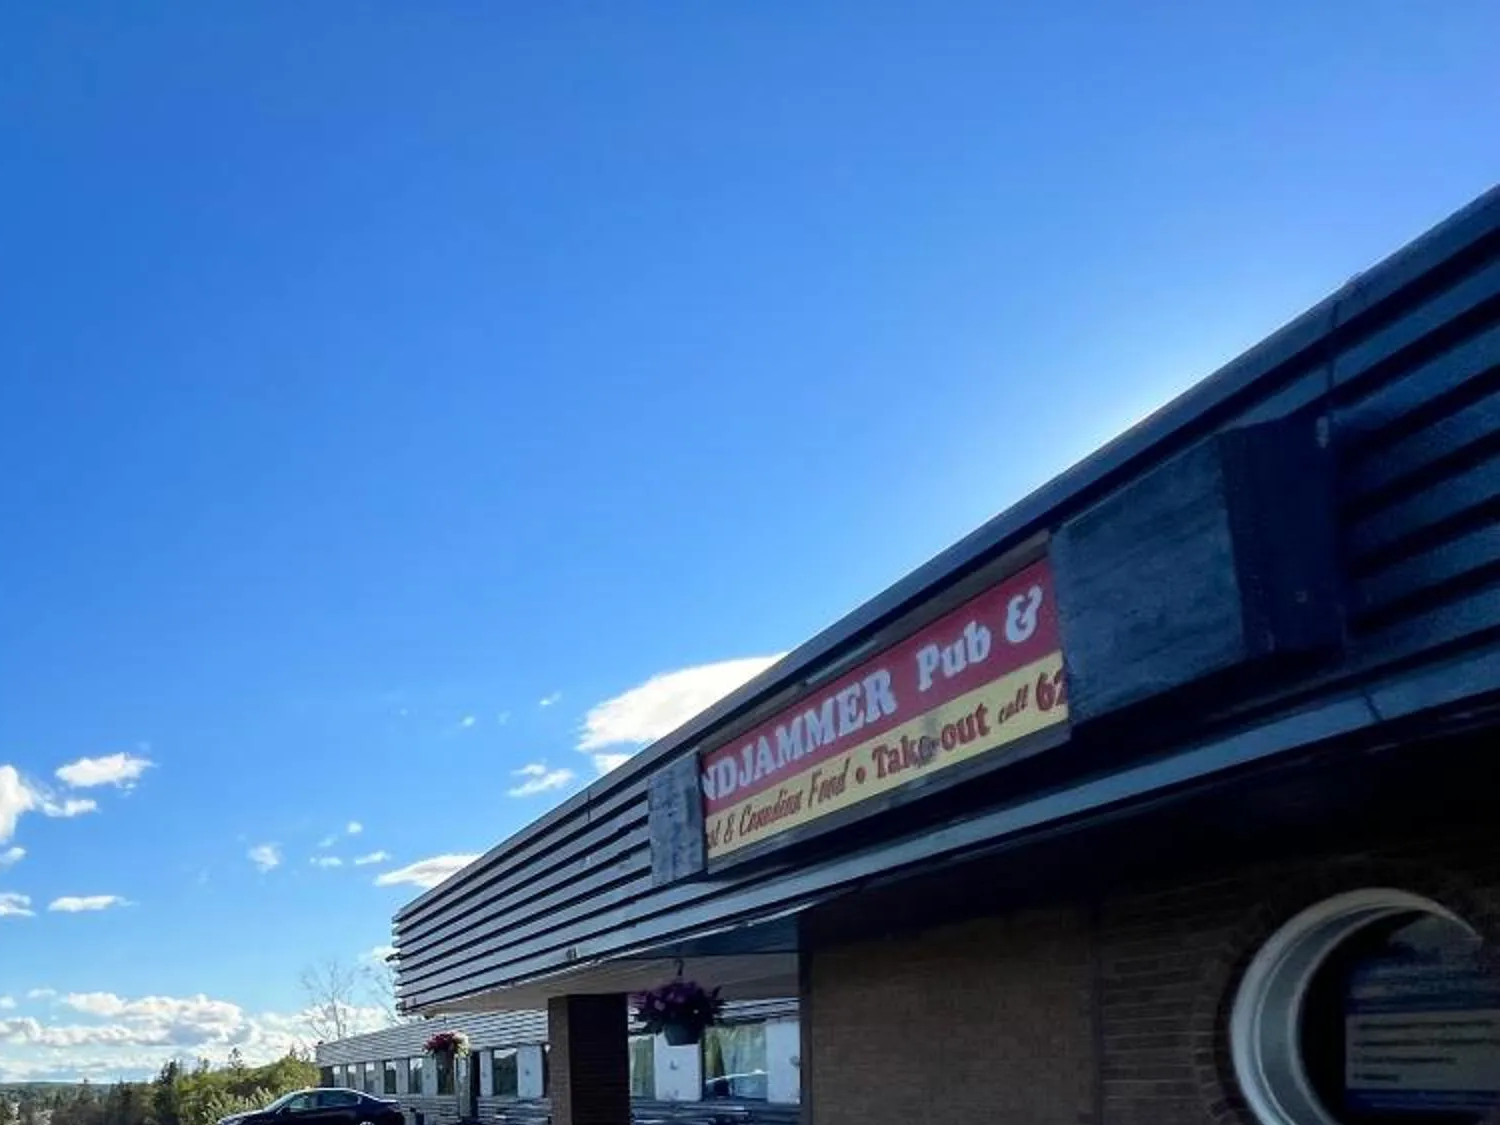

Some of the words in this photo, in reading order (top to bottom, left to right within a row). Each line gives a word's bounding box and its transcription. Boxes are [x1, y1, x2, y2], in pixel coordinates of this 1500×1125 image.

[916, 620, 992, 692] Pub
[1005, 585, 1043, 643] &
[808, 757, 851, 808] Food
[998, 684, 1029, 725] call
